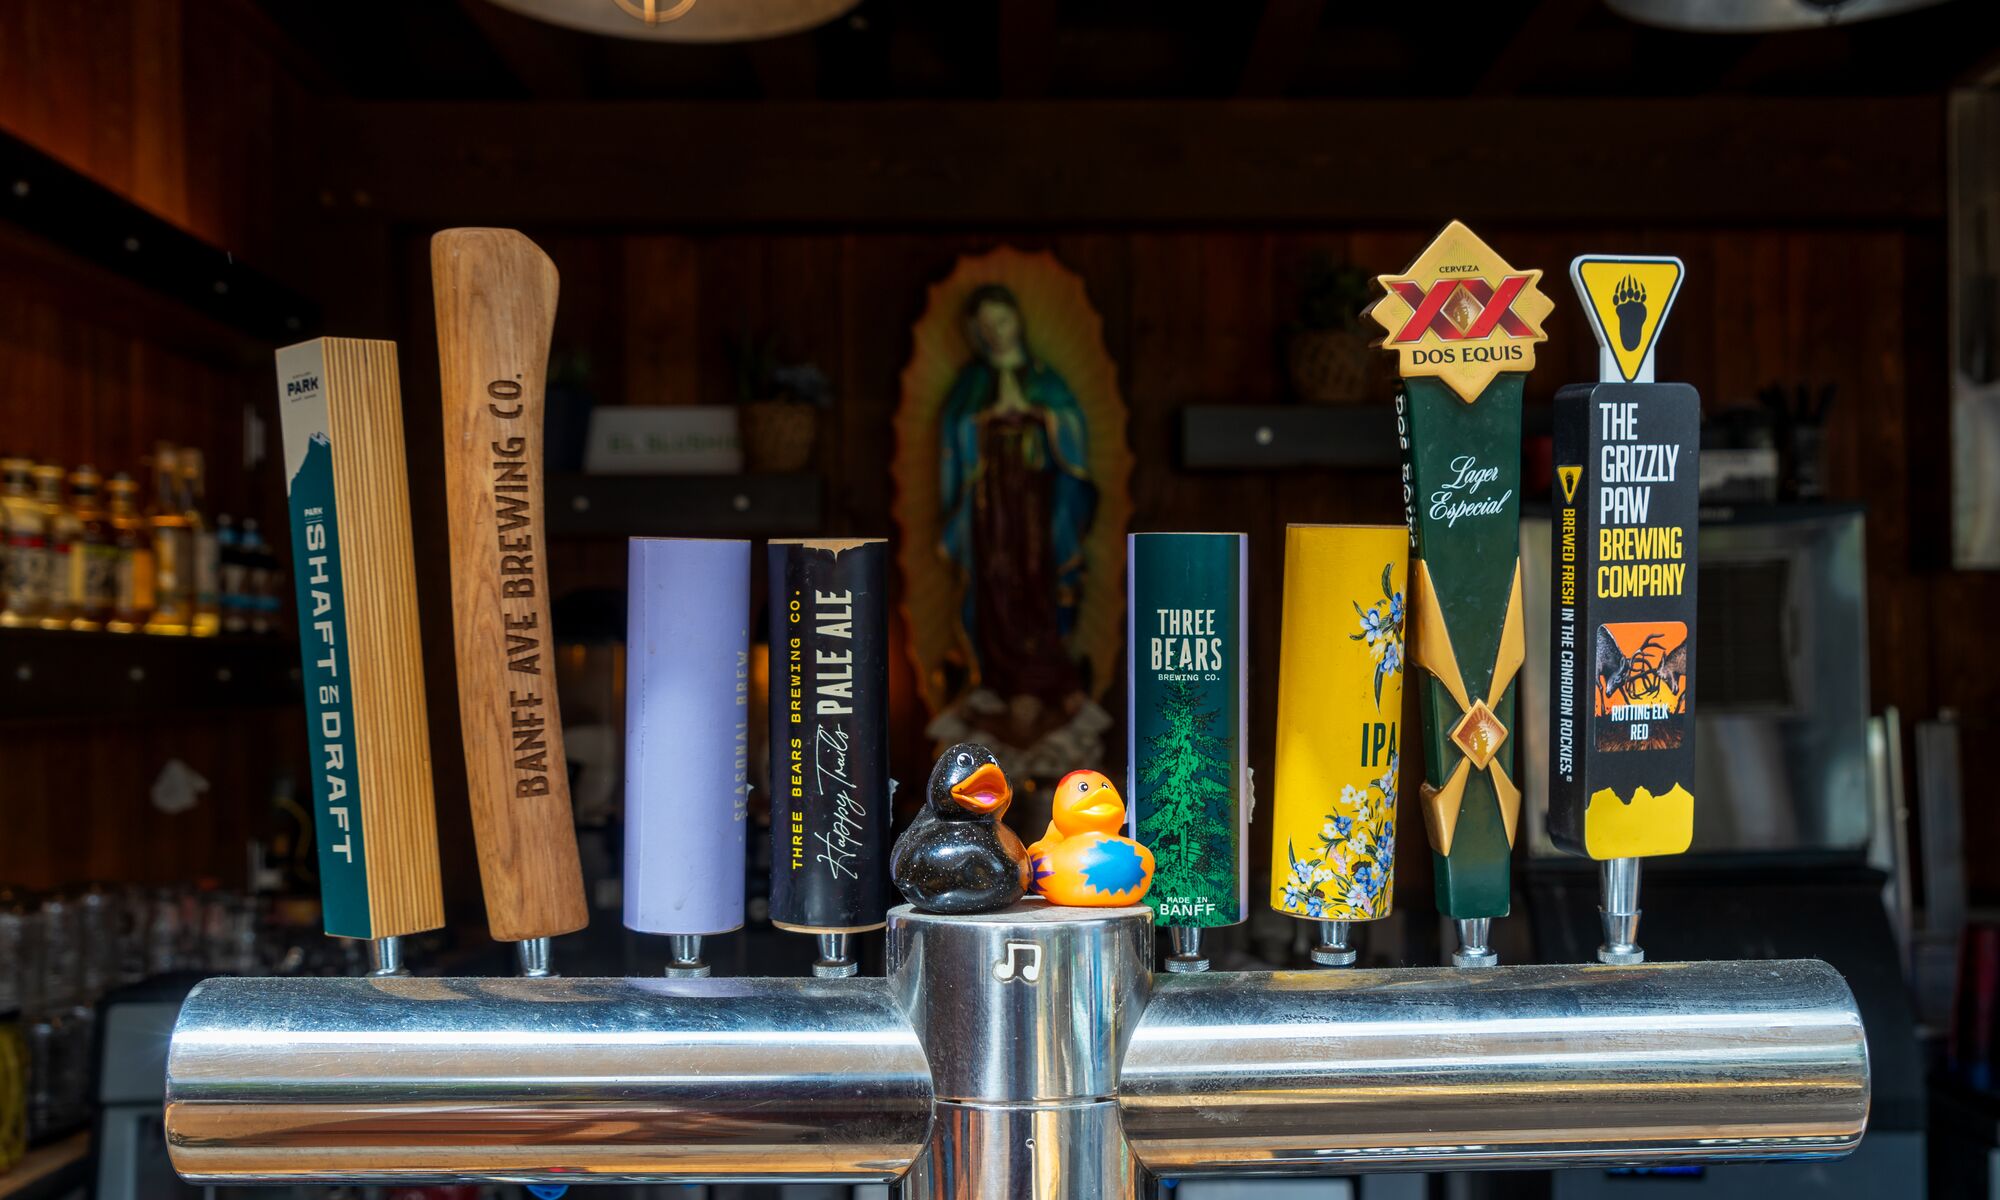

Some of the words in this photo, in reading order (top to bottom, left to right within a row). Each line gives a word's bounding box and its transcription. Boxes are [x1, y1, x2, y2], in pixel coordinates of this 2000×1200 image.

[1439, 265, 1480, 273] CERVEZA
[1387, 275, 1538, 344] XX
[1412, 348, 1456, 365] DOS
[1462, 345, 1523, 363] EQUIS
[287, 376, 319, 397] PARK
[487, 373, 524, 419] CO.
[1599, 402, 1638, 441] THE
[1442, 455, 1499, 492] Lager
[1601, 444, 1680, 483] GRIZZLY
[304, 507, 323, 517] PARK
[491, 436, 535, 600] BREWING
[1429, 489, 1512, 528] Especial
[1600, 486, 1651, 525] PAW
[1562, 508, 1576, 562] BREWED
[1599, 526, 1683, 561] BREWING
[305, 523, 338, 677] SHAFT
[1561, 565, 1575, 605] FRESH
[1597, 563, 1686, 599] COMPANY
[790, 589, 801, 624] CO.
[815, 589, 853, 639] ALE
[1156, 609, 1216, 636] THREE
[1561, 608, 1575, 621] IN
[504, 611, 541, 676] AVE
[1151, 637, 1222, 671] BEARS
[1561, 624, 1574, 648] THE
[790, 637, 801, 723] BREWING
[816, 649, 853, 715] PALE
[1158, 673, 1199, 681] BREWING
[1204, 673, 1220, 681] CO.
[1560, 650, 1574, 715] CANADIAN
[1611, 704, 1651, 722] RUTTING
[1652, 703, 1669, 720] ELK
[1630, 723, 1649, 741] RED
[510, 690, 550, 799] BANFF
[815, 723, 857, 796] Trails
[1361, 721, 1397, 767] IPA
[321, 711, 353, 863] DRAFT
[791, 738, 802, 798] BEARS
[792, 811, 803, 870] THREE
[814, 789, 867, 879] Happy
[1160, 903, 1216, 916] BANFF
[1166, 896, 1190, 904] MADE
